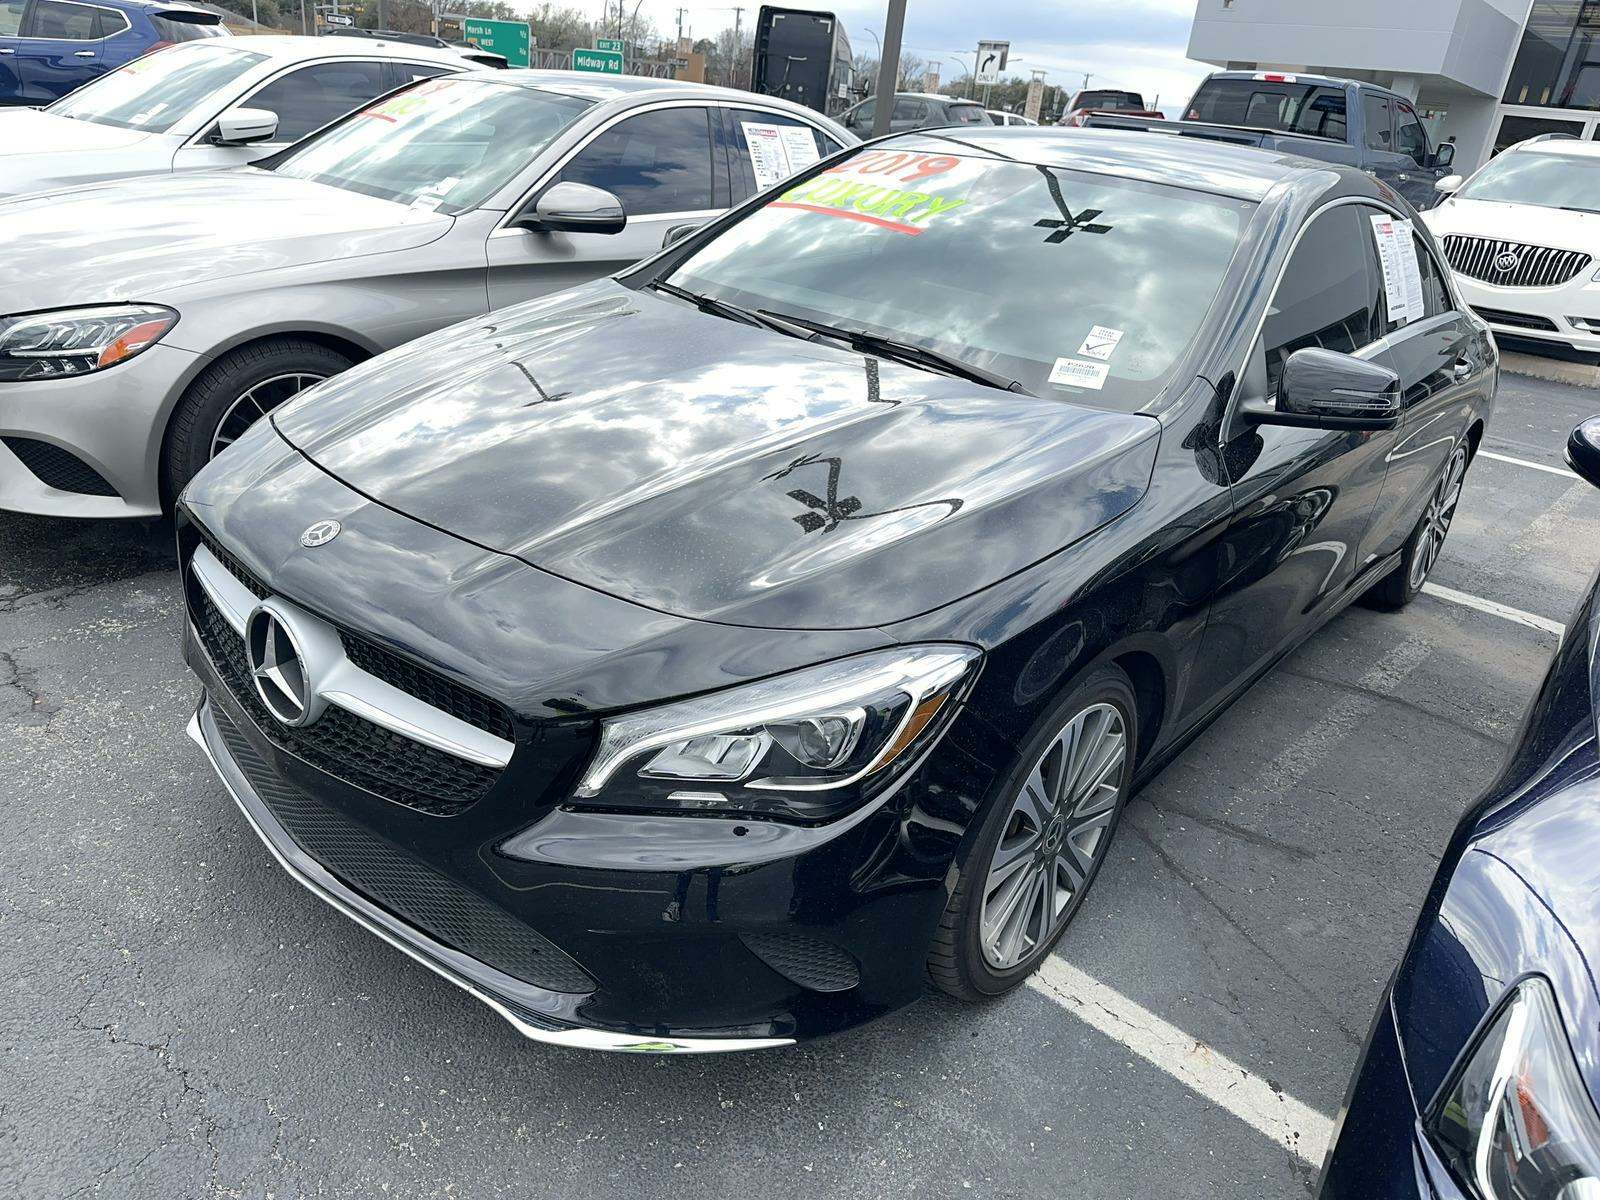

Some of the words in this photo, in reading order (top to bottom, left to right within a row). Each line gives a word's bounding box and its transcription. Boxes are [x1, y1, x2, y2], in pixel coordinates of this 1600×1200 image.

[612, 41, 621, 51] 23
[577, 56, 605, 71] Midway
[608, 60, 619, 70] Rd
[979, 74, 995, 82] ONLY
[823, 152, 961, 182] 2019
[779, 176, 966, 223] LUXURY
